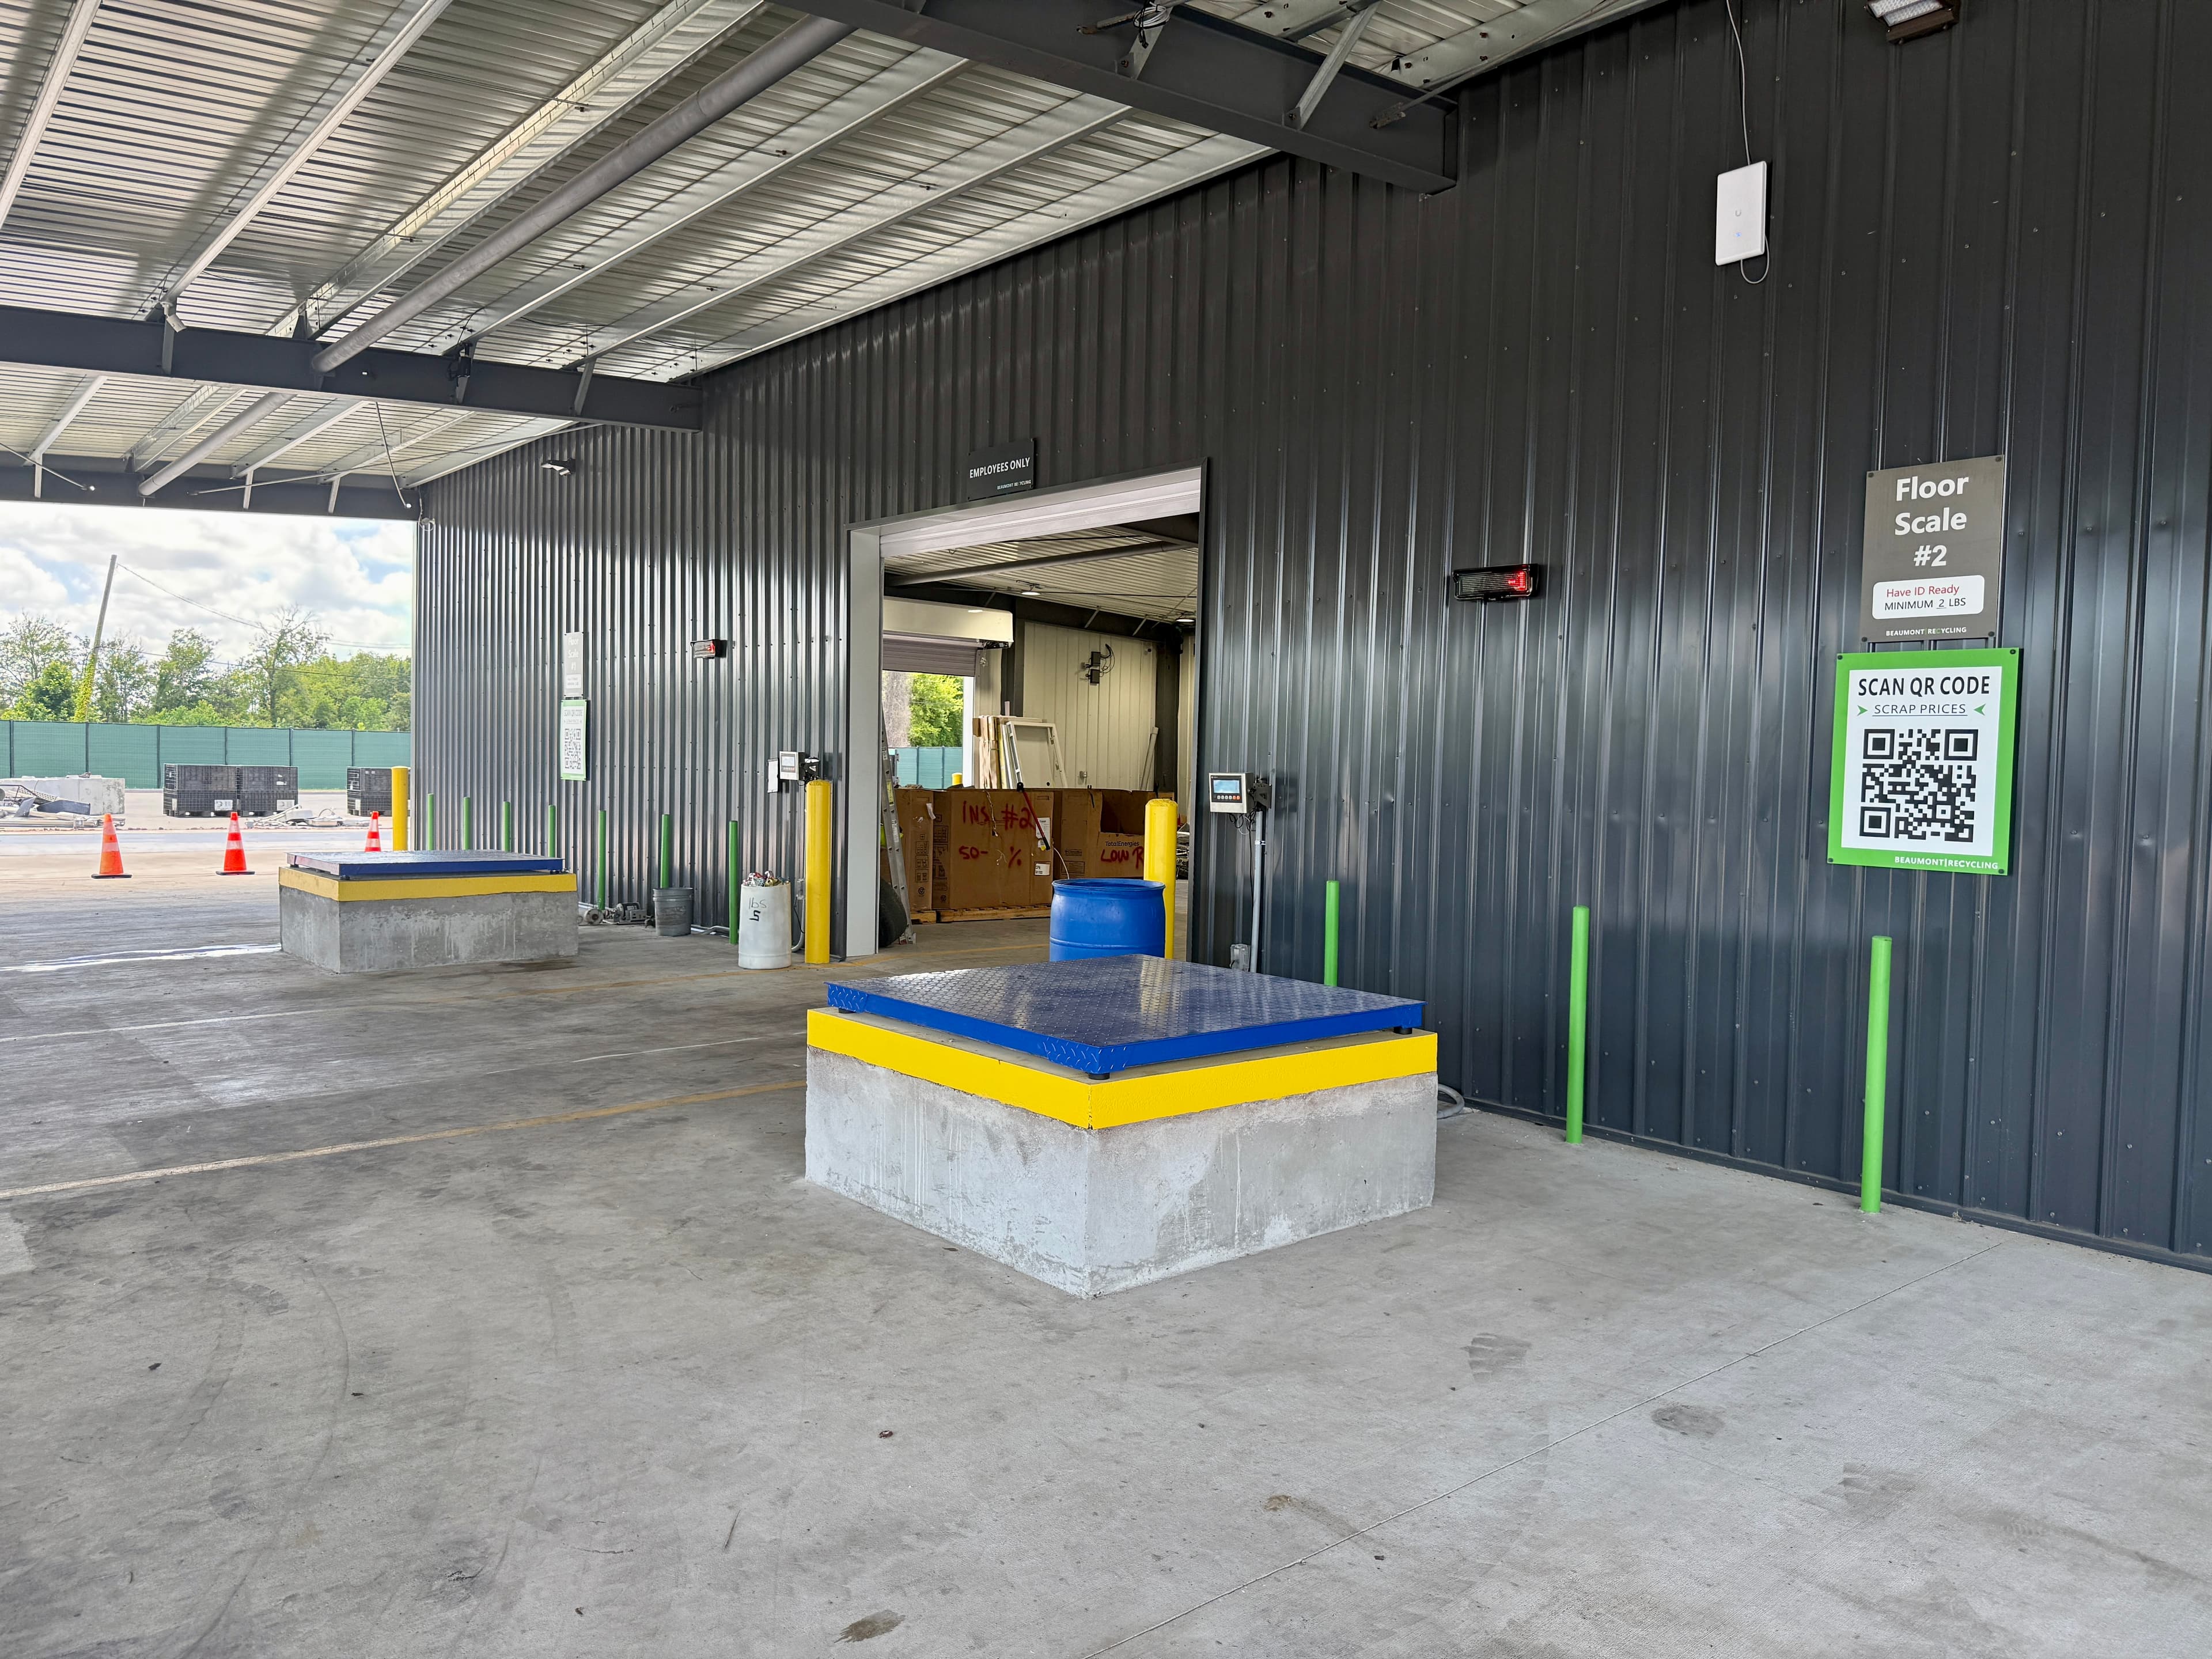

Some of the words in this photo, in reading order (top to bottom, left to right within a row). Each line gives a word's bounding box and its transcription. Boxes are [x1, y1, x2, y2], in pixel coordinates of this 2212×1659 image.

[969, 462, 1009, 478] EMPLOYEES
[1010, 457, 1030, 470] ONLY
[1896, 476, 1968, 501] Floor
[1895, 507, 1967, 535] Scale
[1913, 545, 1946, 567] #2
[1887, 589, 1911, 597] Have
[1915, 586, 1925, 595] ID
[1929, 584, 1959, 596] Ready
[1885, 600, 1933, 611] MINIMUM
[1949, 598, 1966, 607] LBS
[1858, 677, 1904, 696] SCAN
[1910, 677, 1934, 697] QR
[1940, 676, 1990, 695] CODE
[1874, 704, 1916, 714] SCRAP
[1920, 704, 1965, 714] PRICES
